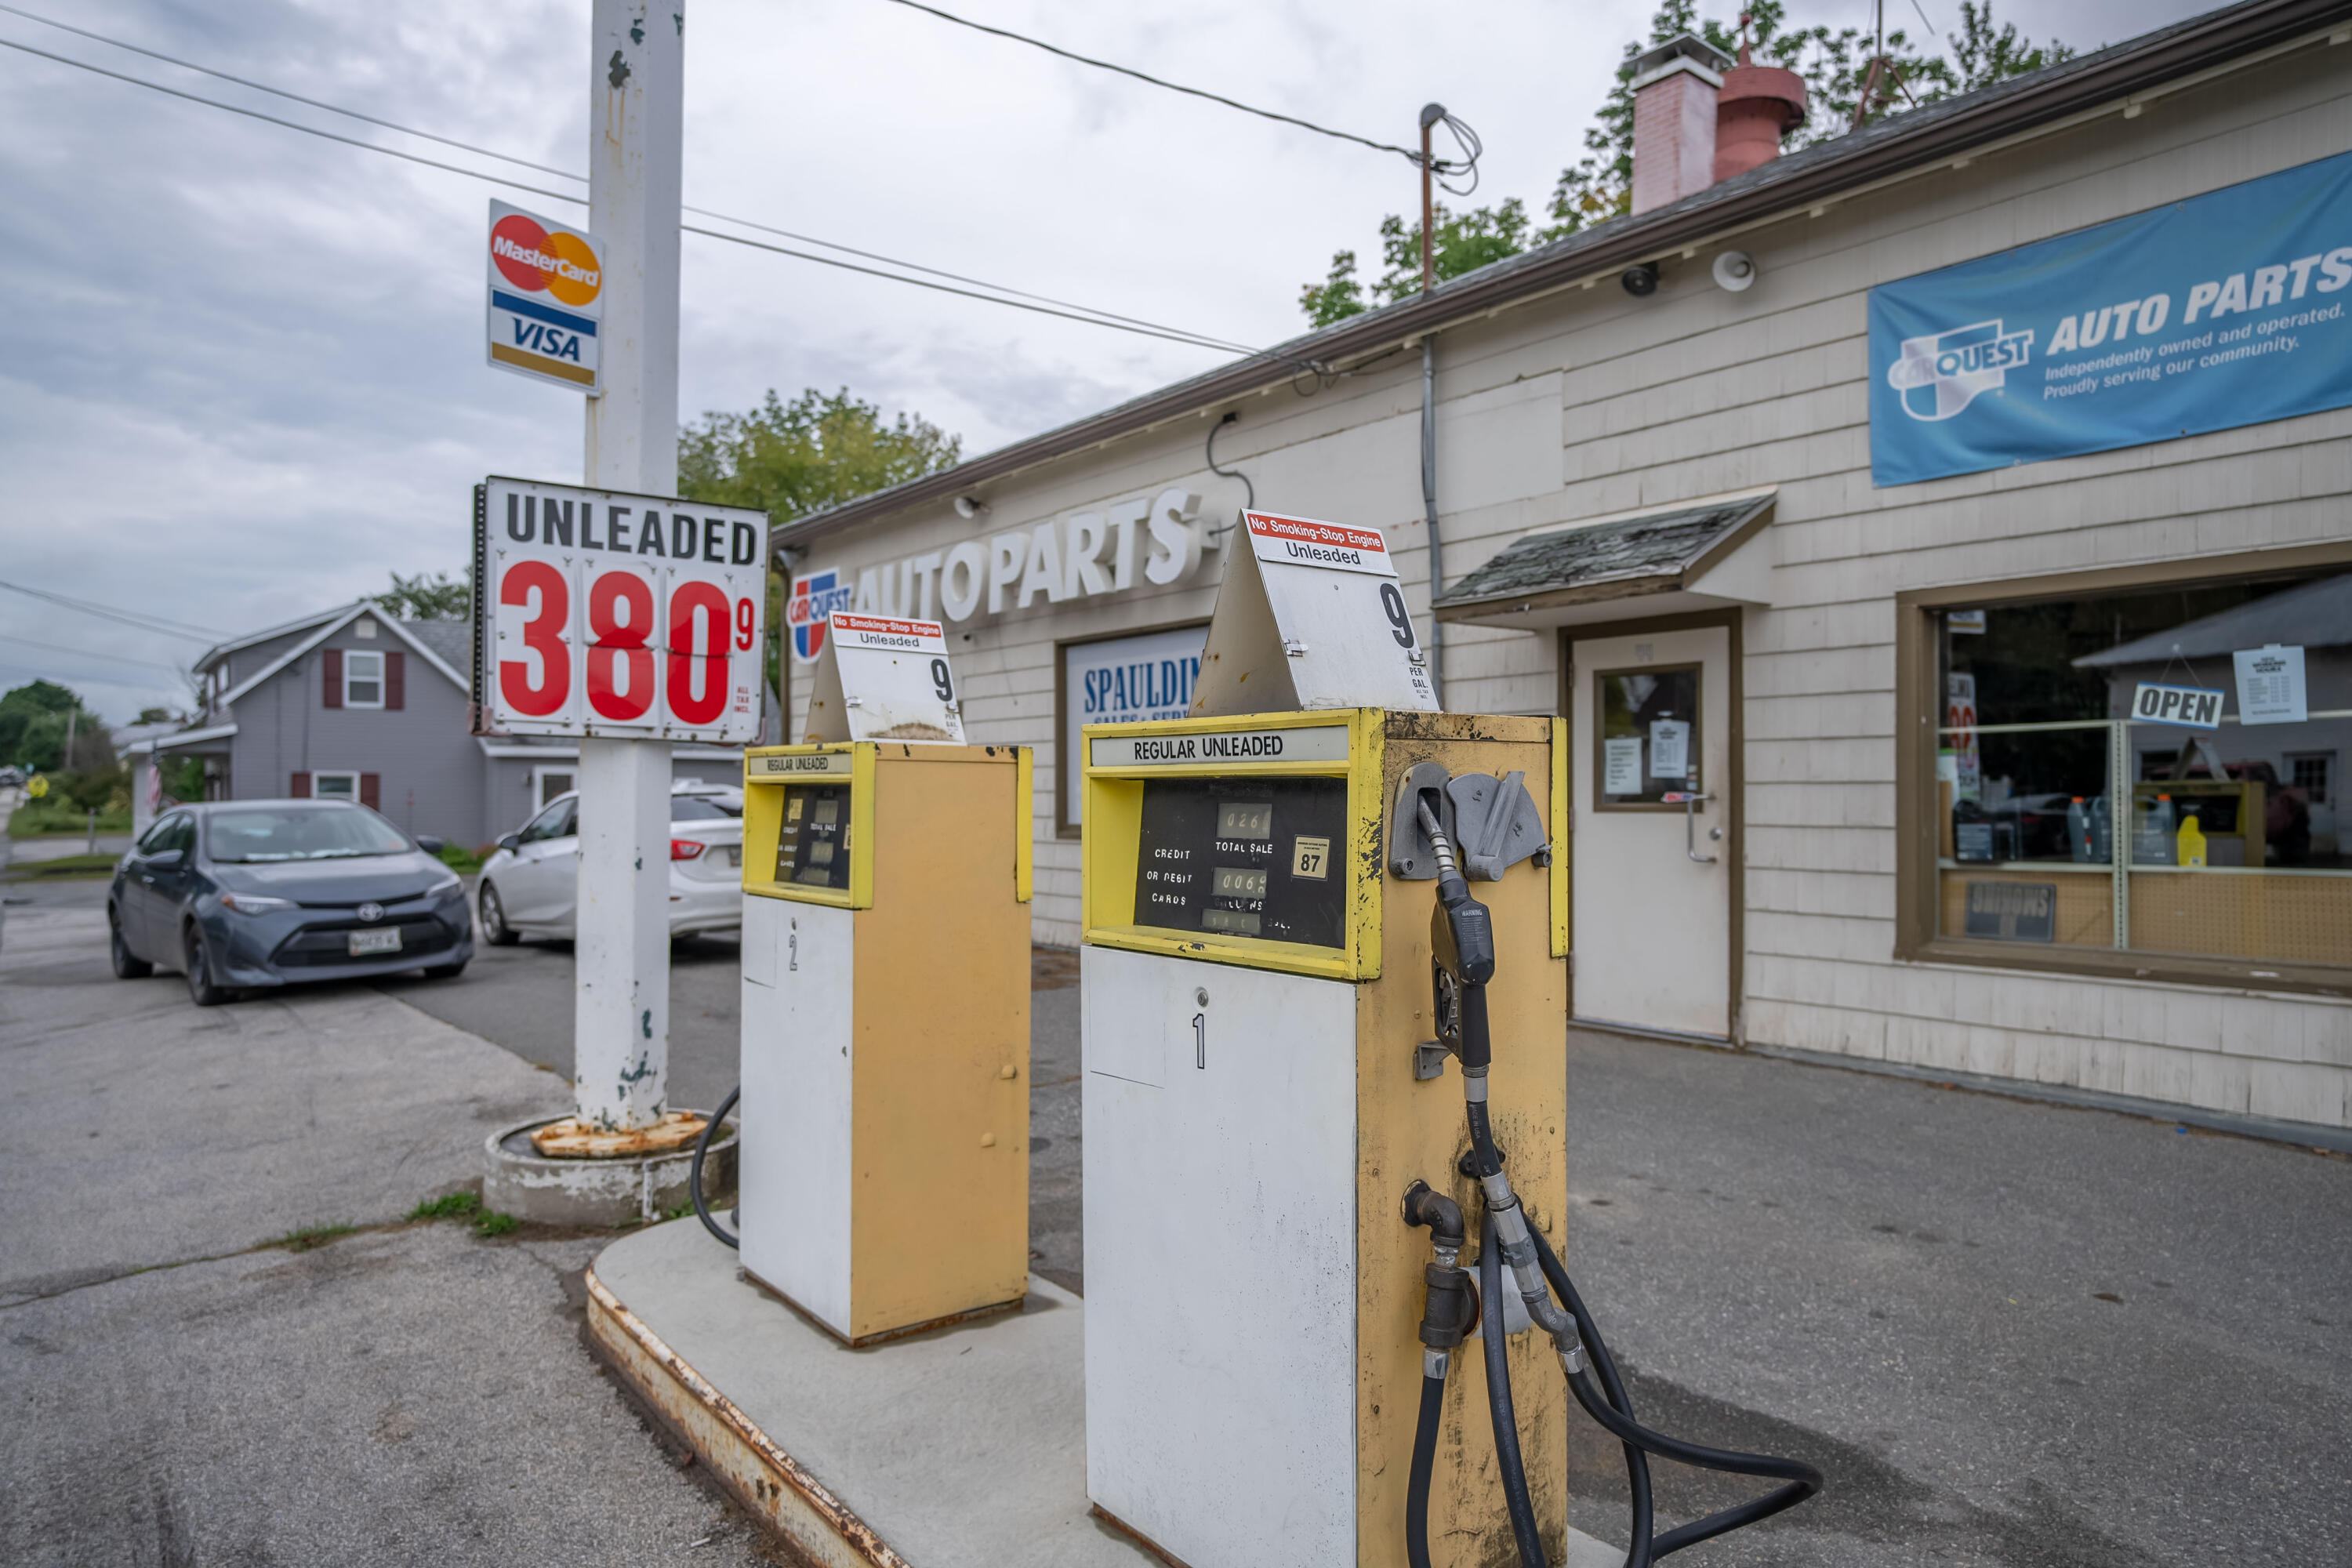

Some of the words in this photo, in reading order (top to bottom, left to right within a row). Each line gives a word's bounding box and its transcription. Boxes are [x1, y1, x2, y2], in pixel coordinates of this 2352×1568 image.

[493, 235, 599, 288] MasterCard
[2045, 293, 2171, 356] AUTO
[2183, 246, 2352, 325] PARTS
[512, 316, 582, 363] VISA
[2045, 345, 2154, 381] Independently
[2158, 332, 2213, 358] owned
[2218, 323, 2252, 345] and
[2256, 303, 2346, 336] operated.
[2043, 373, 2100, 401] Proudly
[2103, 364, 2161, 389] serving
[2165, 358, 2195, 376] our
[2199, 336, 2300, 369] community.
[506, 492, 757, 566] UNLEADED
[1250, 517, 1268, 531] No
[1270, 520, 1345, 544] Smoking-Stop
[1347, 532, 1381, 548] Engine
[1286, 542, 1362, 565] Unleaded
[834, 615, 848, 626] No
[850, 618, 910, 633] Smoking-Stop
[912, 625, 940, 635] Engine
[1380, 583, 1414, 649] 9
[499, 560, 732, 725] 380
[735, 597, 755, 652] 9
[860, 633, 920, 648] Unleaded
[931, 658, 953, 702] 9
[1409, 667, 1424, 676] PER
[1412, 679, 1428, 688] GAL.
[2140, 688, 2218, 723] OPEN
[767, 759, 794, 771] REGULAR
[795, 757, 829, 771] UNLEADED
[1134, 739, 1196, 761] REGULAR
[1203, 735, 1283, 758] UNLEADED
[1155, 848, 1190, 859] CREDIT
[1215, 841, 1245, 852] TOTAL
[1250, 843, 1273, 854] SALE
[1301, 854, 1320, 873] 87
[1147, 870, 1159, 880] OR
[789, 934, 798, 971] 2
[1192, 1012, 1205, 1070] 1
